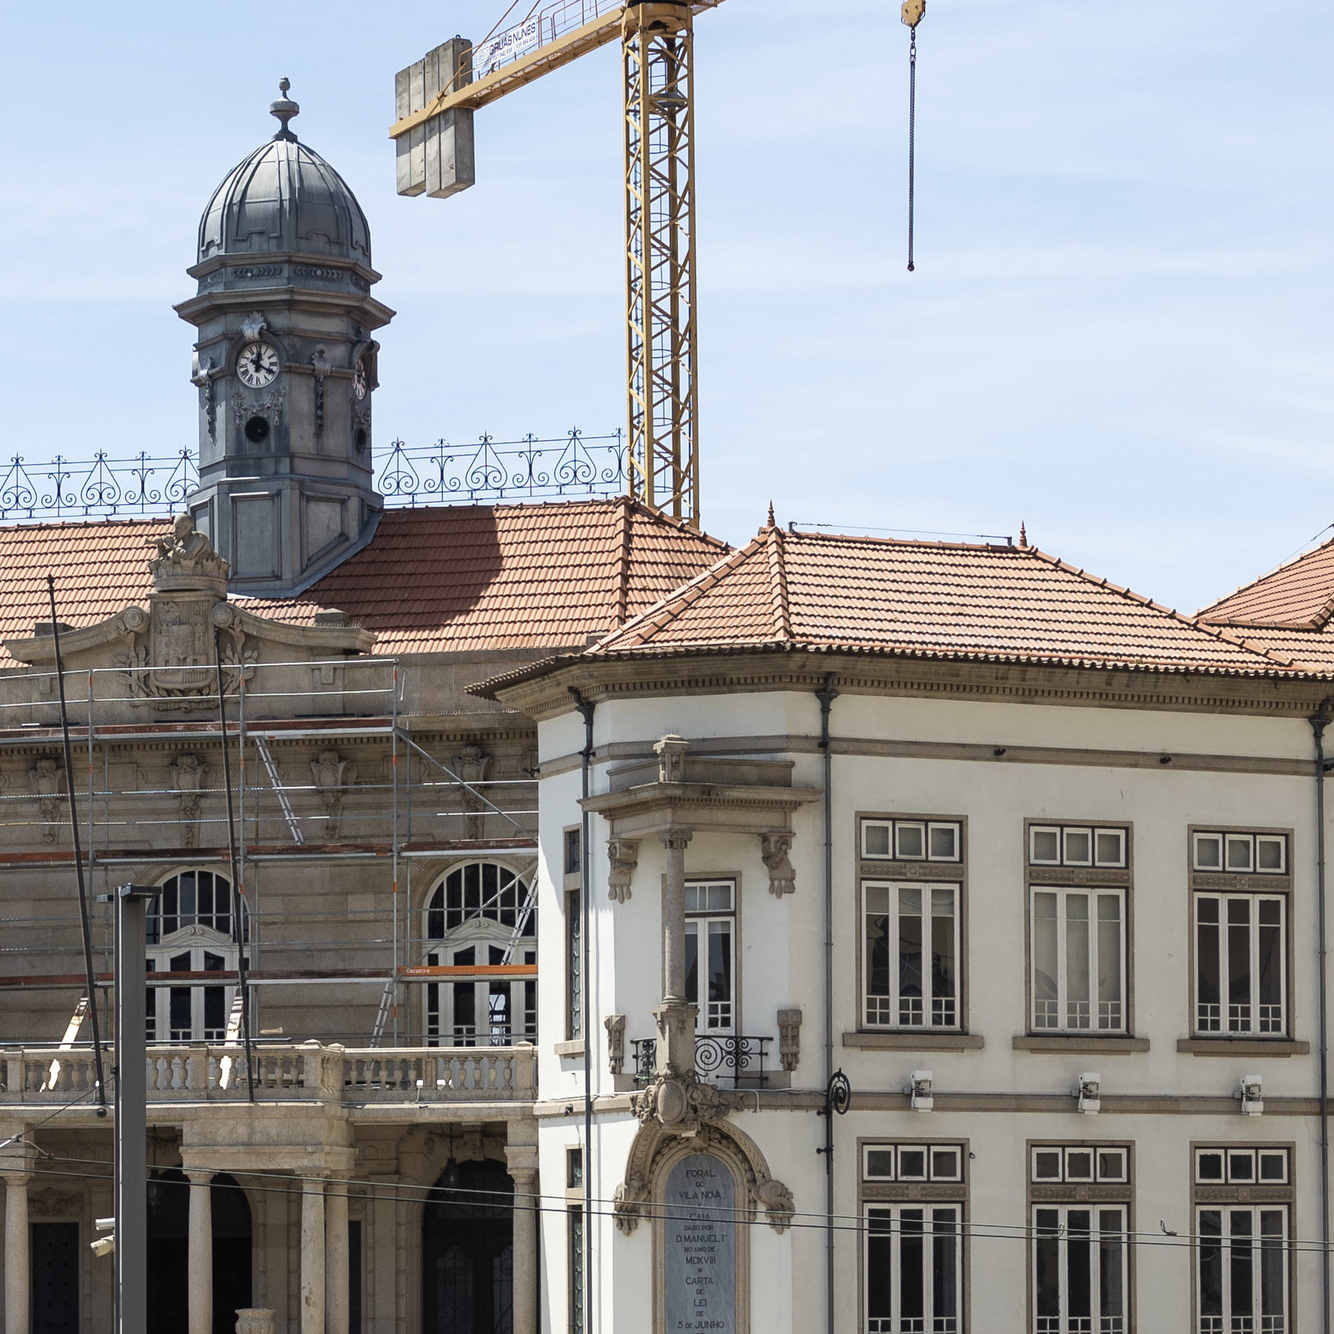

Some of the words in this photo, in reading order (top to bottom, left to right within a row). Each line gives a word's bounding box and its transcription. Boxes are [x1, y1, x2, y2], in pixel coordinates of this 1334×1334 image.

[512, 22, 536, 41] NUNES
[686, 1169, 715, 1178] FORAL
[679, 1191, 698, 1200] VILA
[701, 1191, 721, 1199] NOVA
[685, 1277, 714, 1285] CARTA
[693, 1298, 707, 1307] LEI
[695, 1320, 725, 1329] JUNHO
